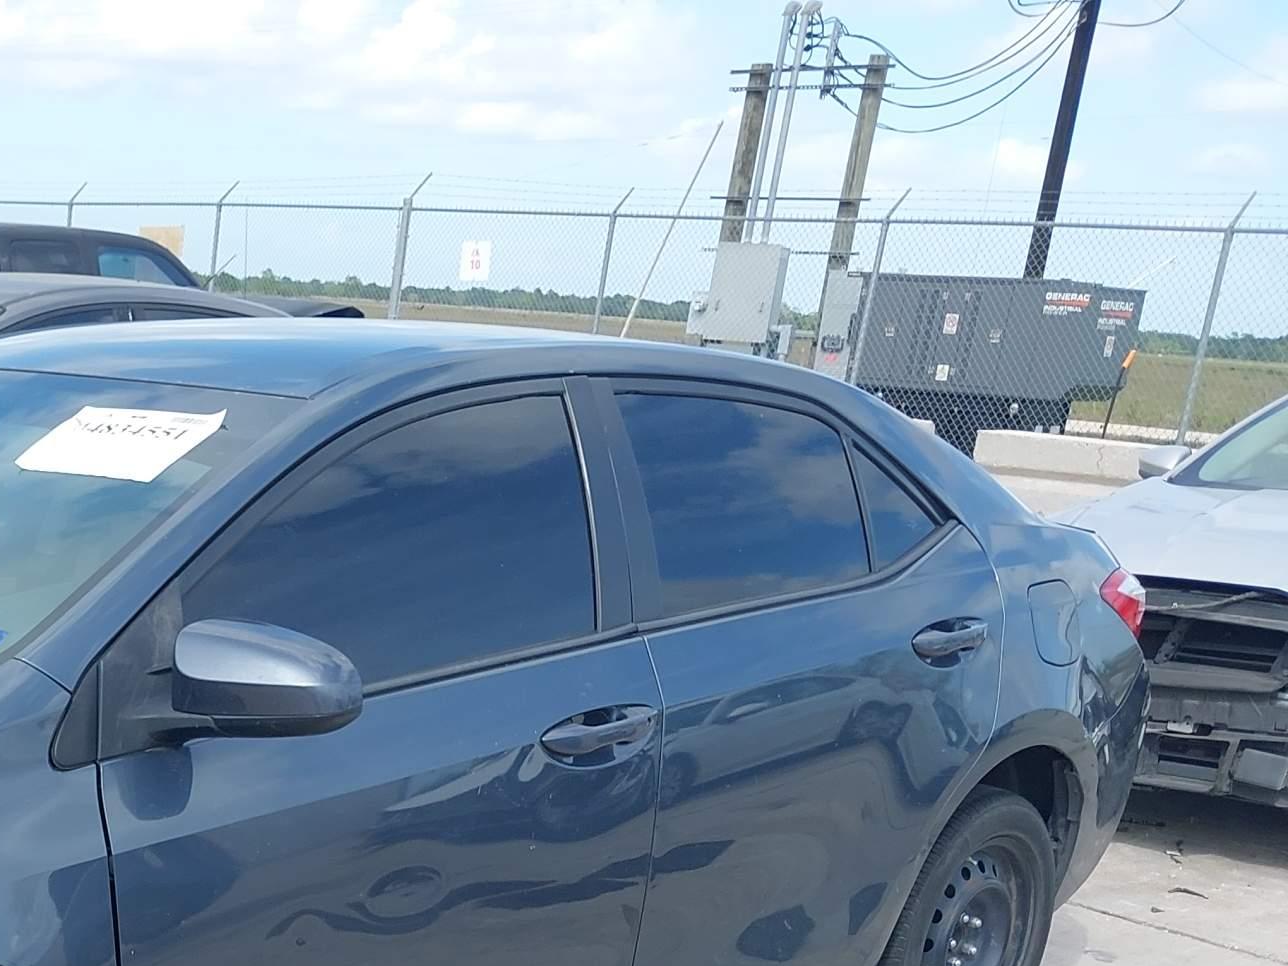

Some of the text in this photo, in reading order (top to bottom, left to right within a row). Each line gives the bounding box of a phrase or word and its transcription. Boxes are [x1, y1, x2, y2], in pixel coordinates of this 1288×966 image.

[470, 259, 481, 270] 10
[1045, 291, 1091, 302] GENERAC
[1100, 300, 1135, 312] GENERAC
